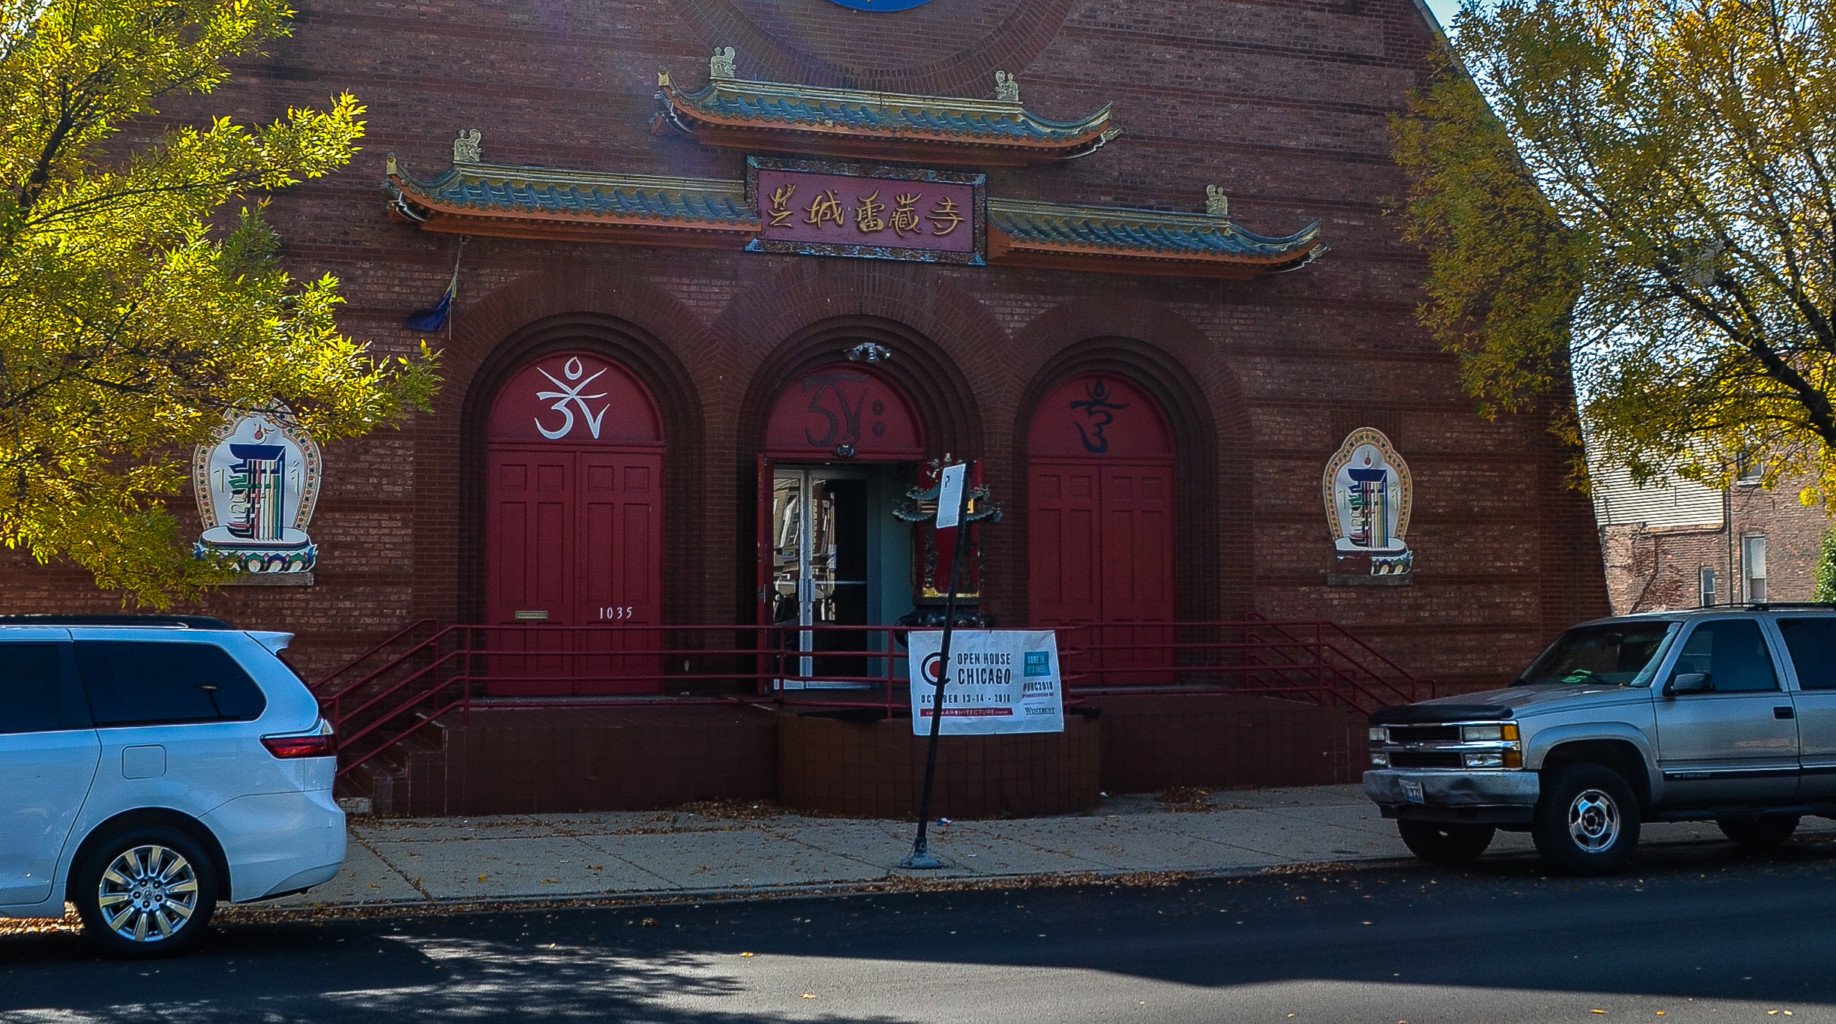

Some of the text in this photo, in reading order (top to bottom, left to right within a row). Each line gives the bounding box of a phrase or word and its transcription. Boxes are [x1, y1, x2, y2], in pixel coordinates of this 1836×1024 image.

[599, 606, 633, 619] 1035
[957, 652, 1011, 665] OPEN HOUSE
[957, 668, 1011, 685] CHICAGO
[921, 694, 958, 704] OCBER
[962, 693, 984, 703] 13-14
[995, 693, 1011, 703] 2018
